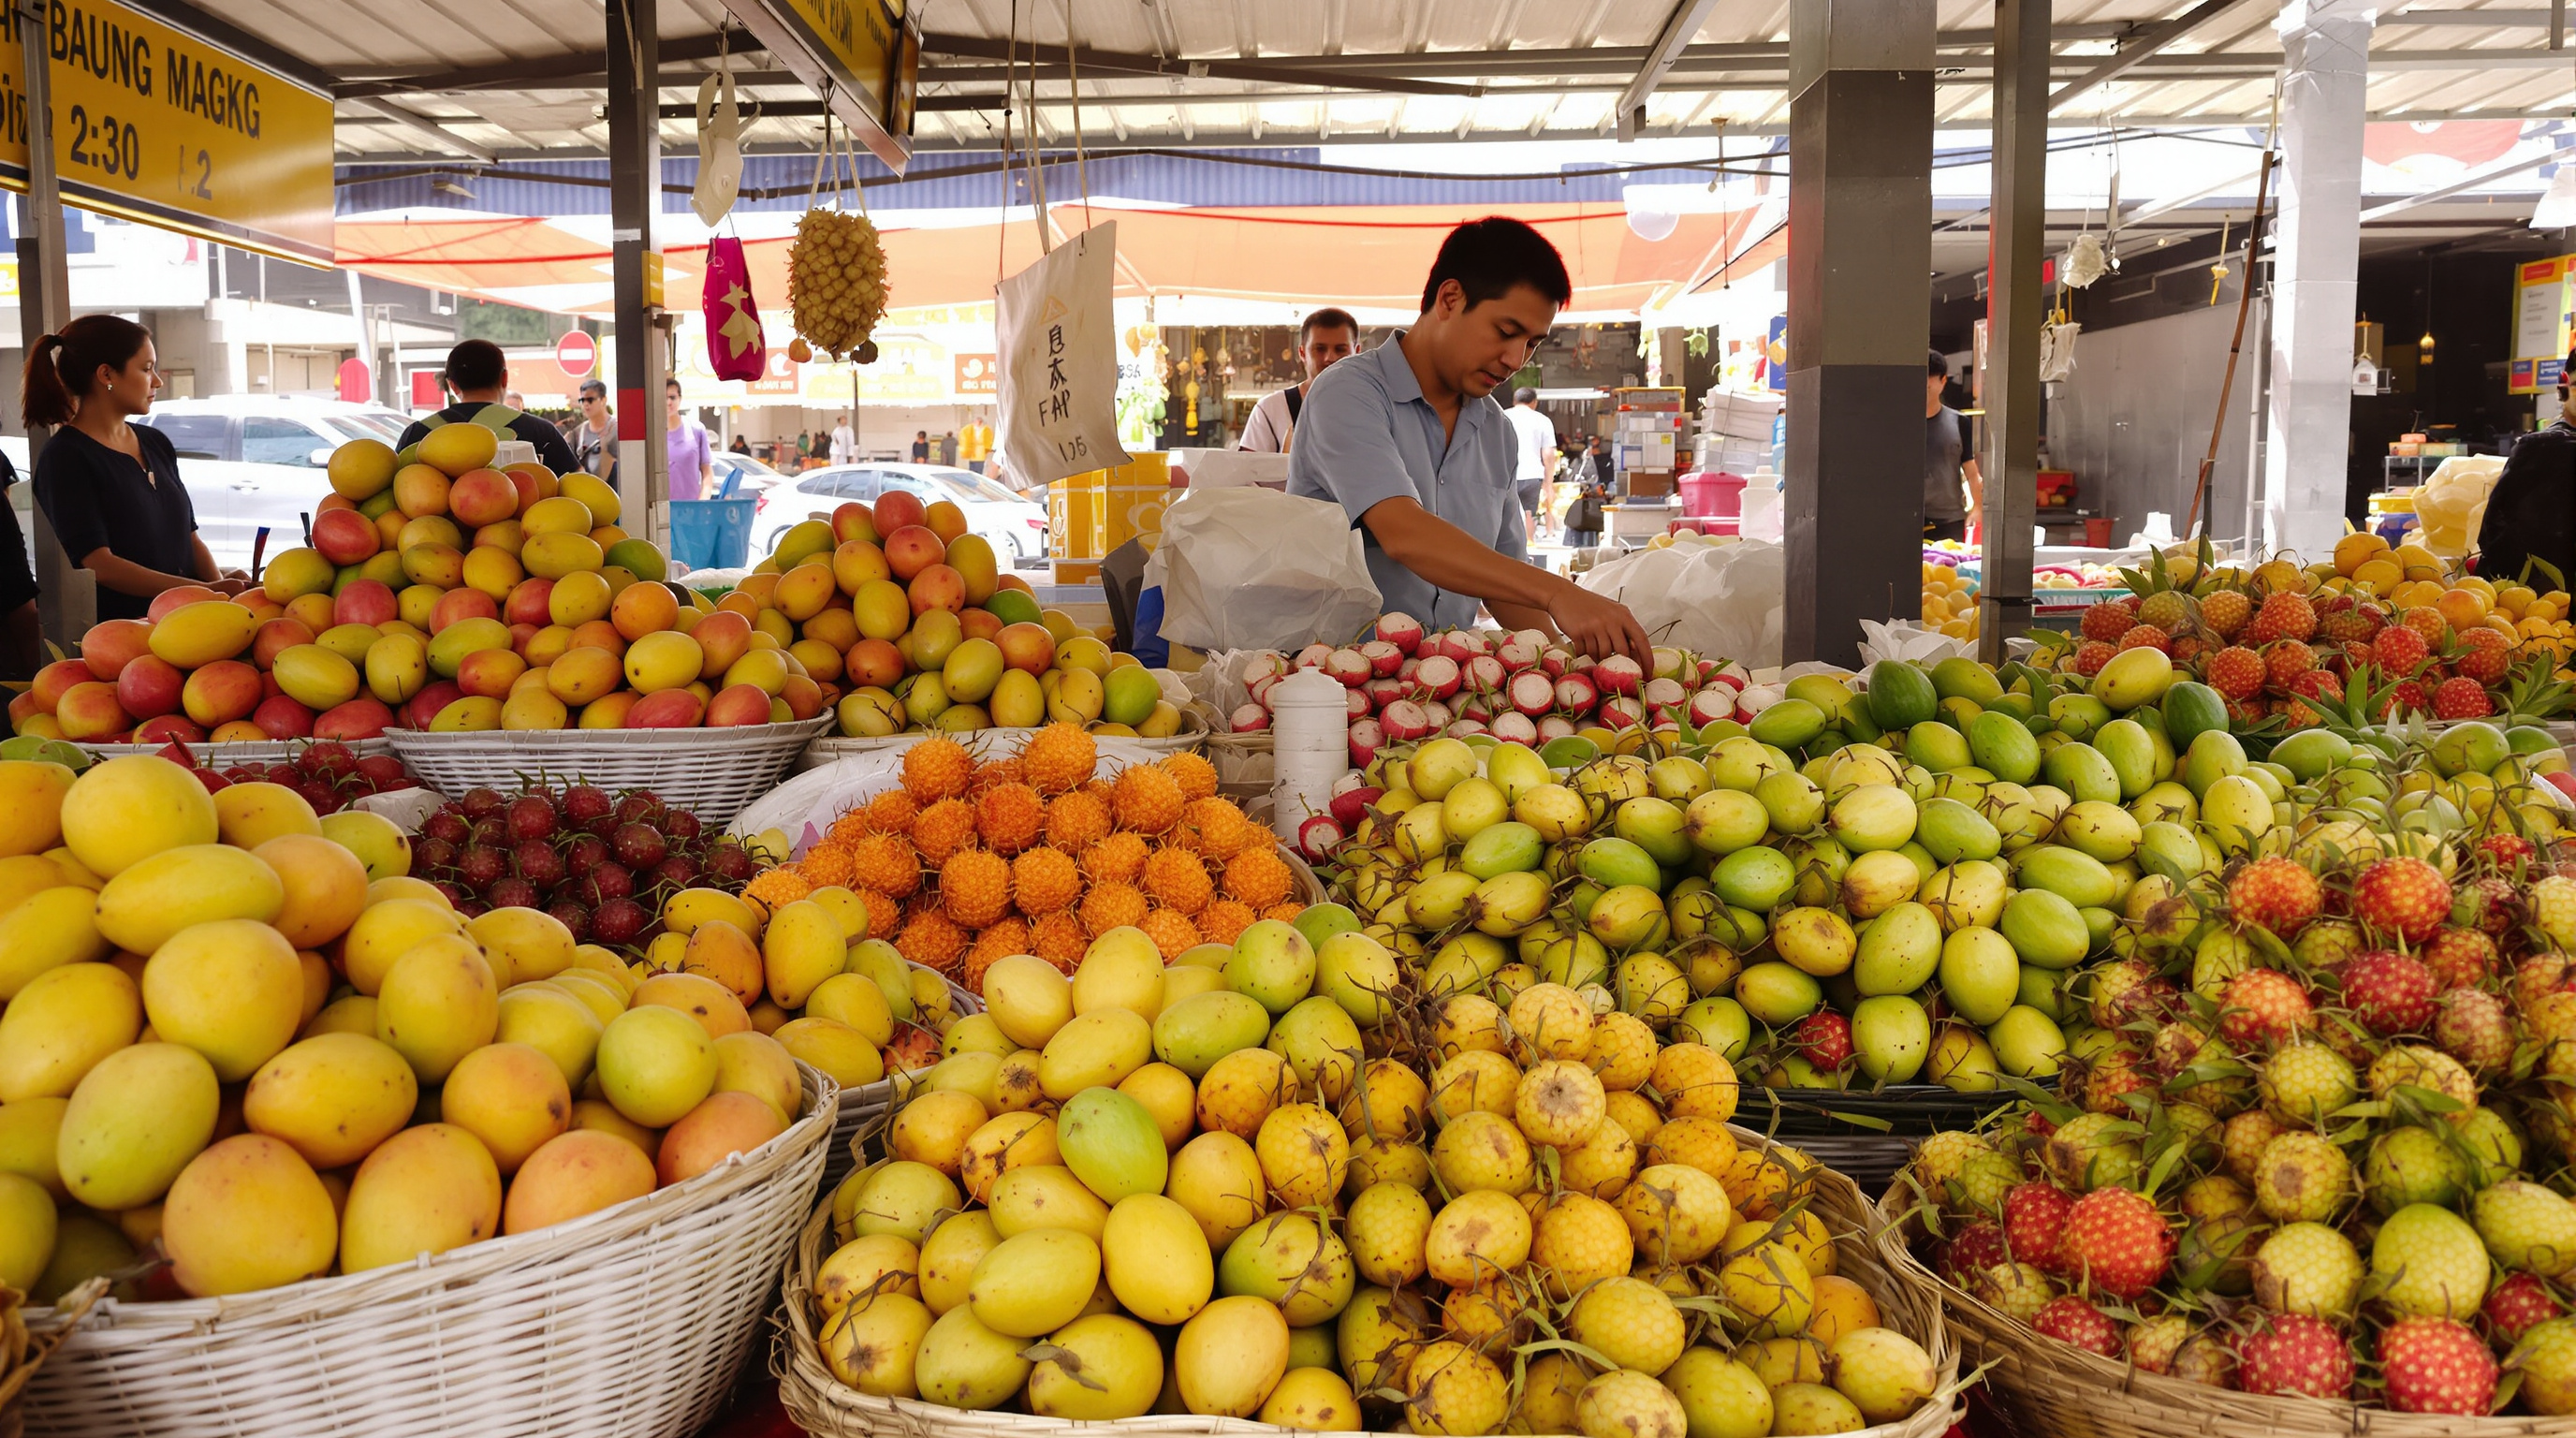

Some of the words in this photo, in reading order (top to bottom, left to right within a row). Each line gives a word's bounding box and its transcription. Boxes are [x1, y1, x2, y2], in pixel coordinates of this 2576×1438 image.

[51, 0, 152, 97] BAUNG
[168, 48, 260, 139] MAGKG
[70, 105, 139, 181] 2:30
